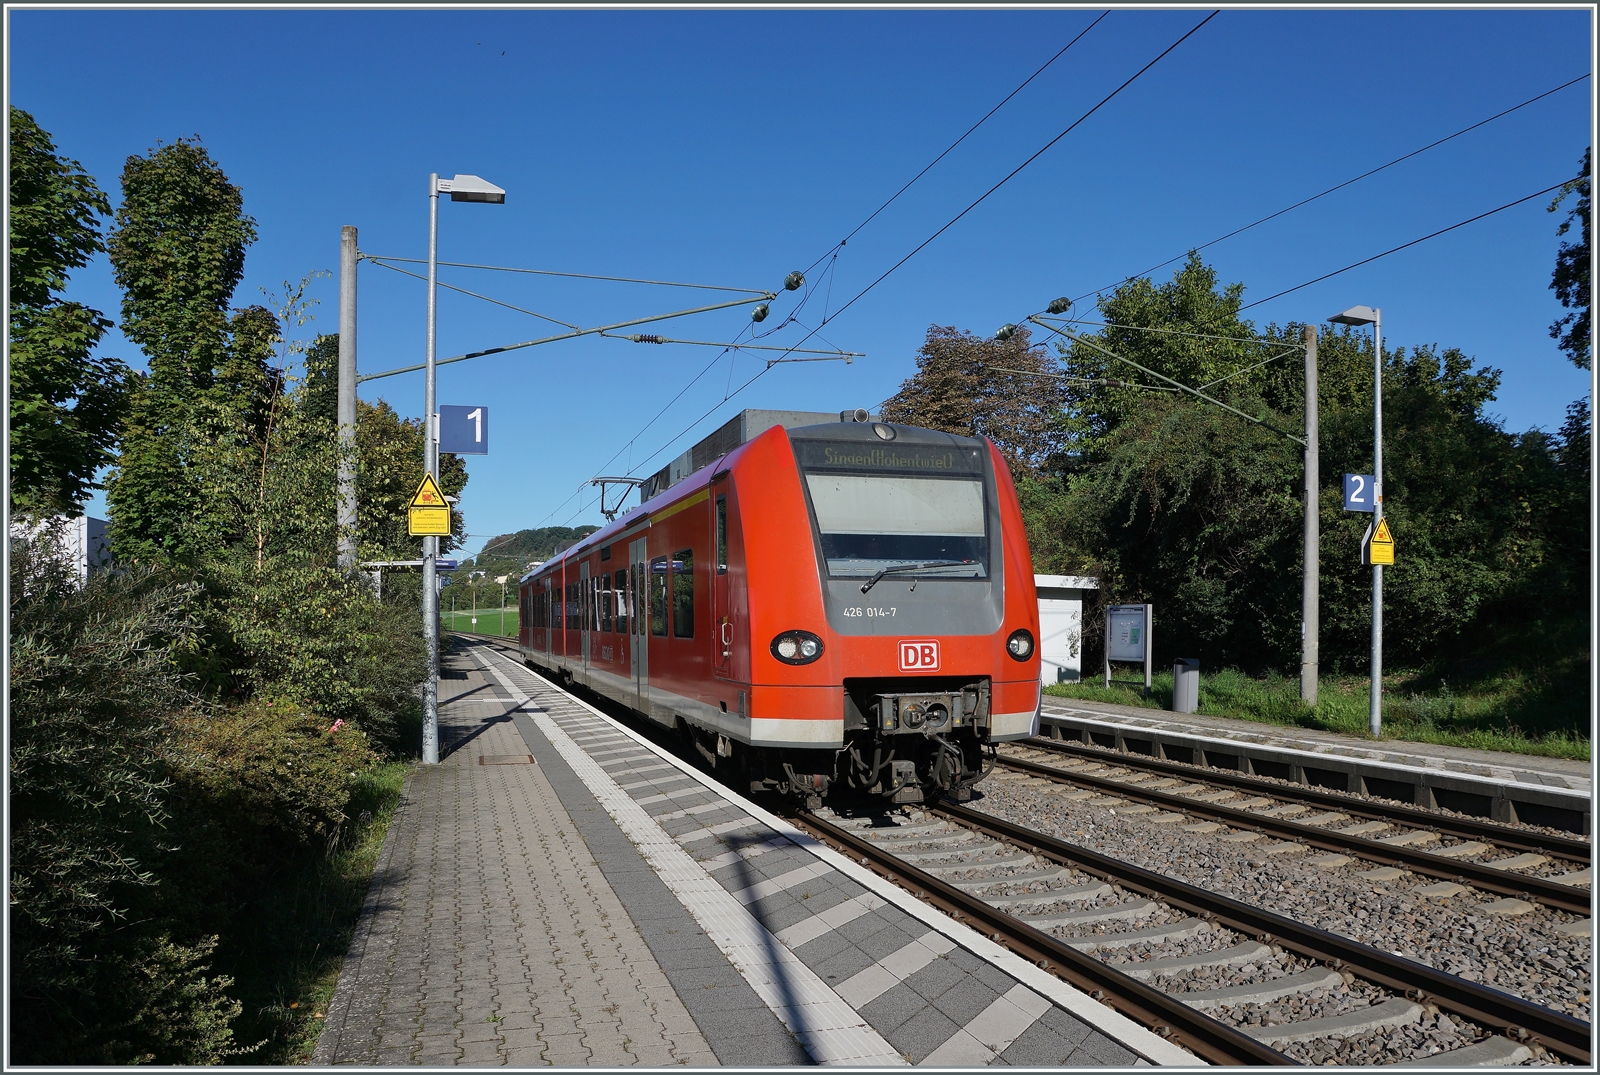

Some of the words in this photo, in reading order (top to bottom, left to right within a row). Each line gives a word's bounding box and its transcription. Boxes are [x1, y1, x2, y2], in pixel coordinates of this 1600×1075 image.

[467, 408, 482, 443] 1
[824, 447, 954, 469] Singen(Hohentwiel)
[1350, 475, 1365, 503] 2
[843, 607, 863, 617] 426
[866, 607, 897, 617] 014-7
[903, 645, 935, 667] DB
